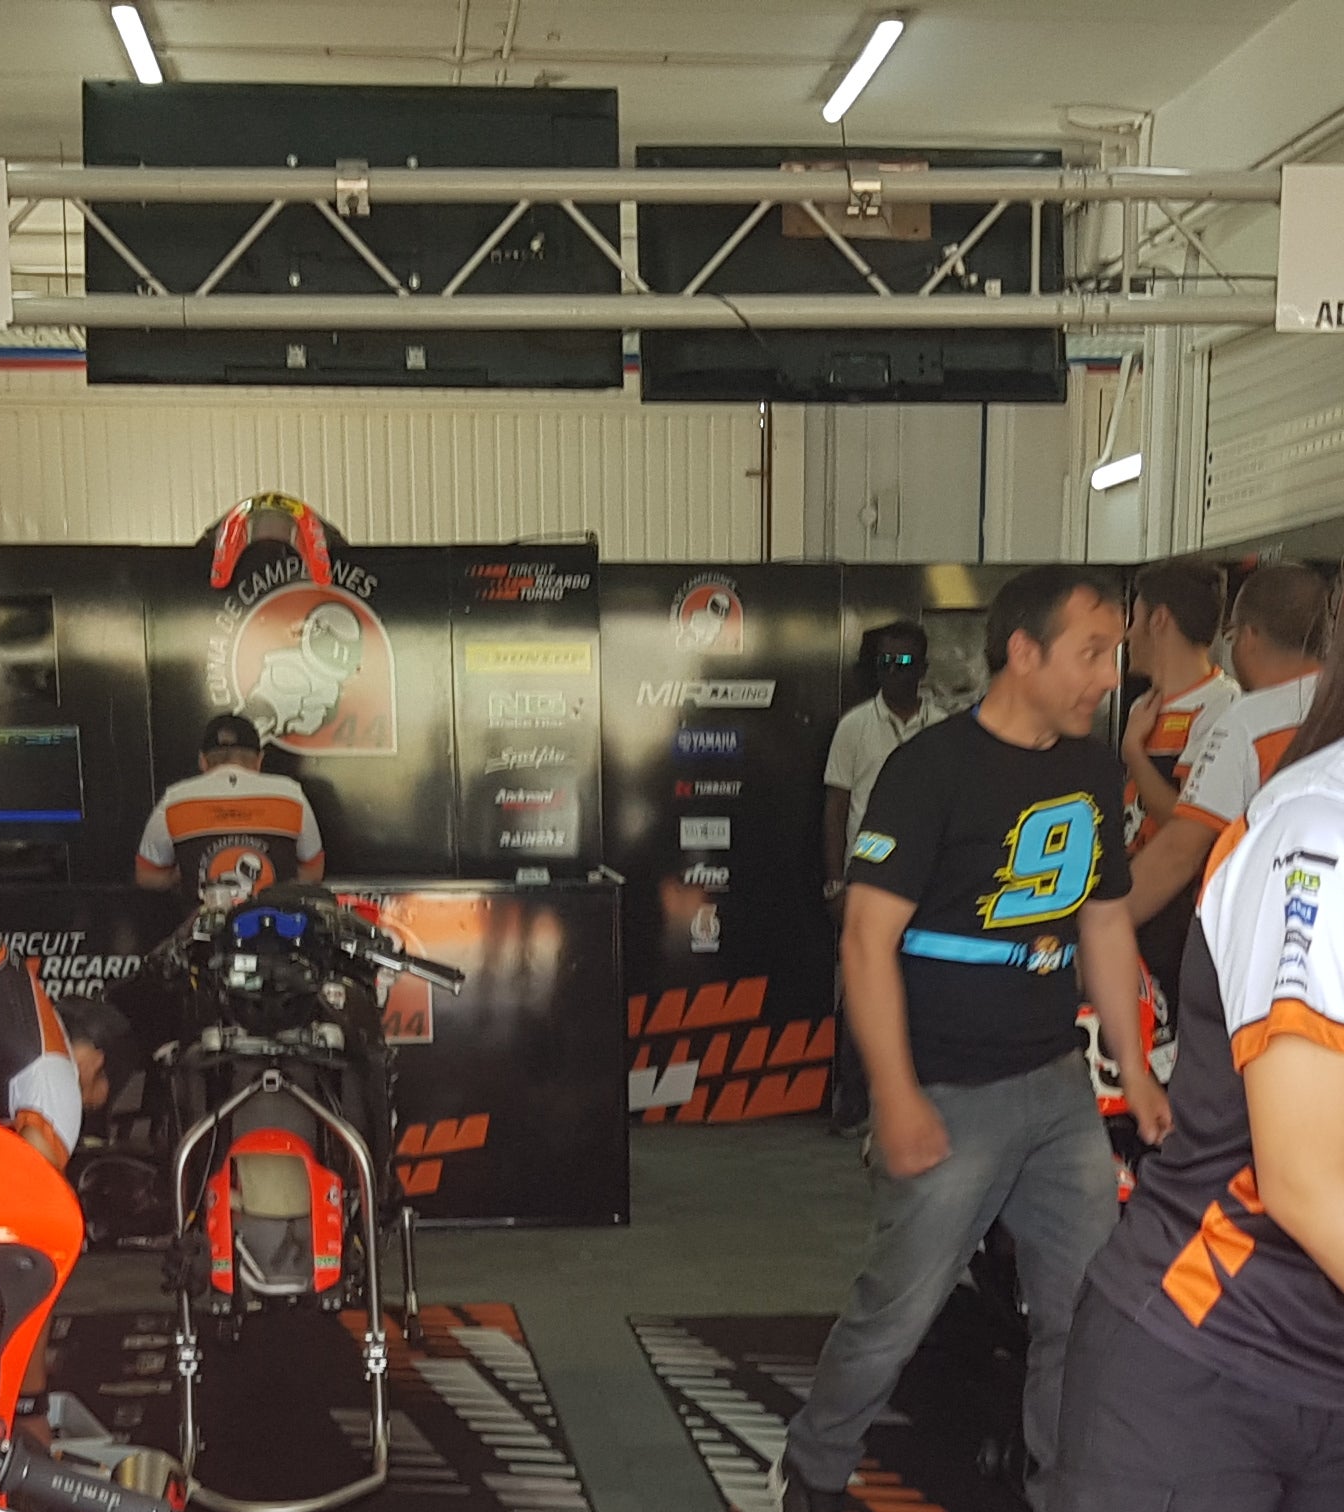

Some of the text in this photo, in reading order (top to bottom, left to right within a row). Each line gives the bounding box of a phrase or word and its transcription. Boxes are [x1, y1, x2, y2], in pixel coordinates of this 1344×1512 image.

[534, 573, 591, 590] RICARDO
[978, 794, 1104, 929] 9
[2, 931, 86, 957] IRCUIT
[42, 954, 146, 980] RICARD
